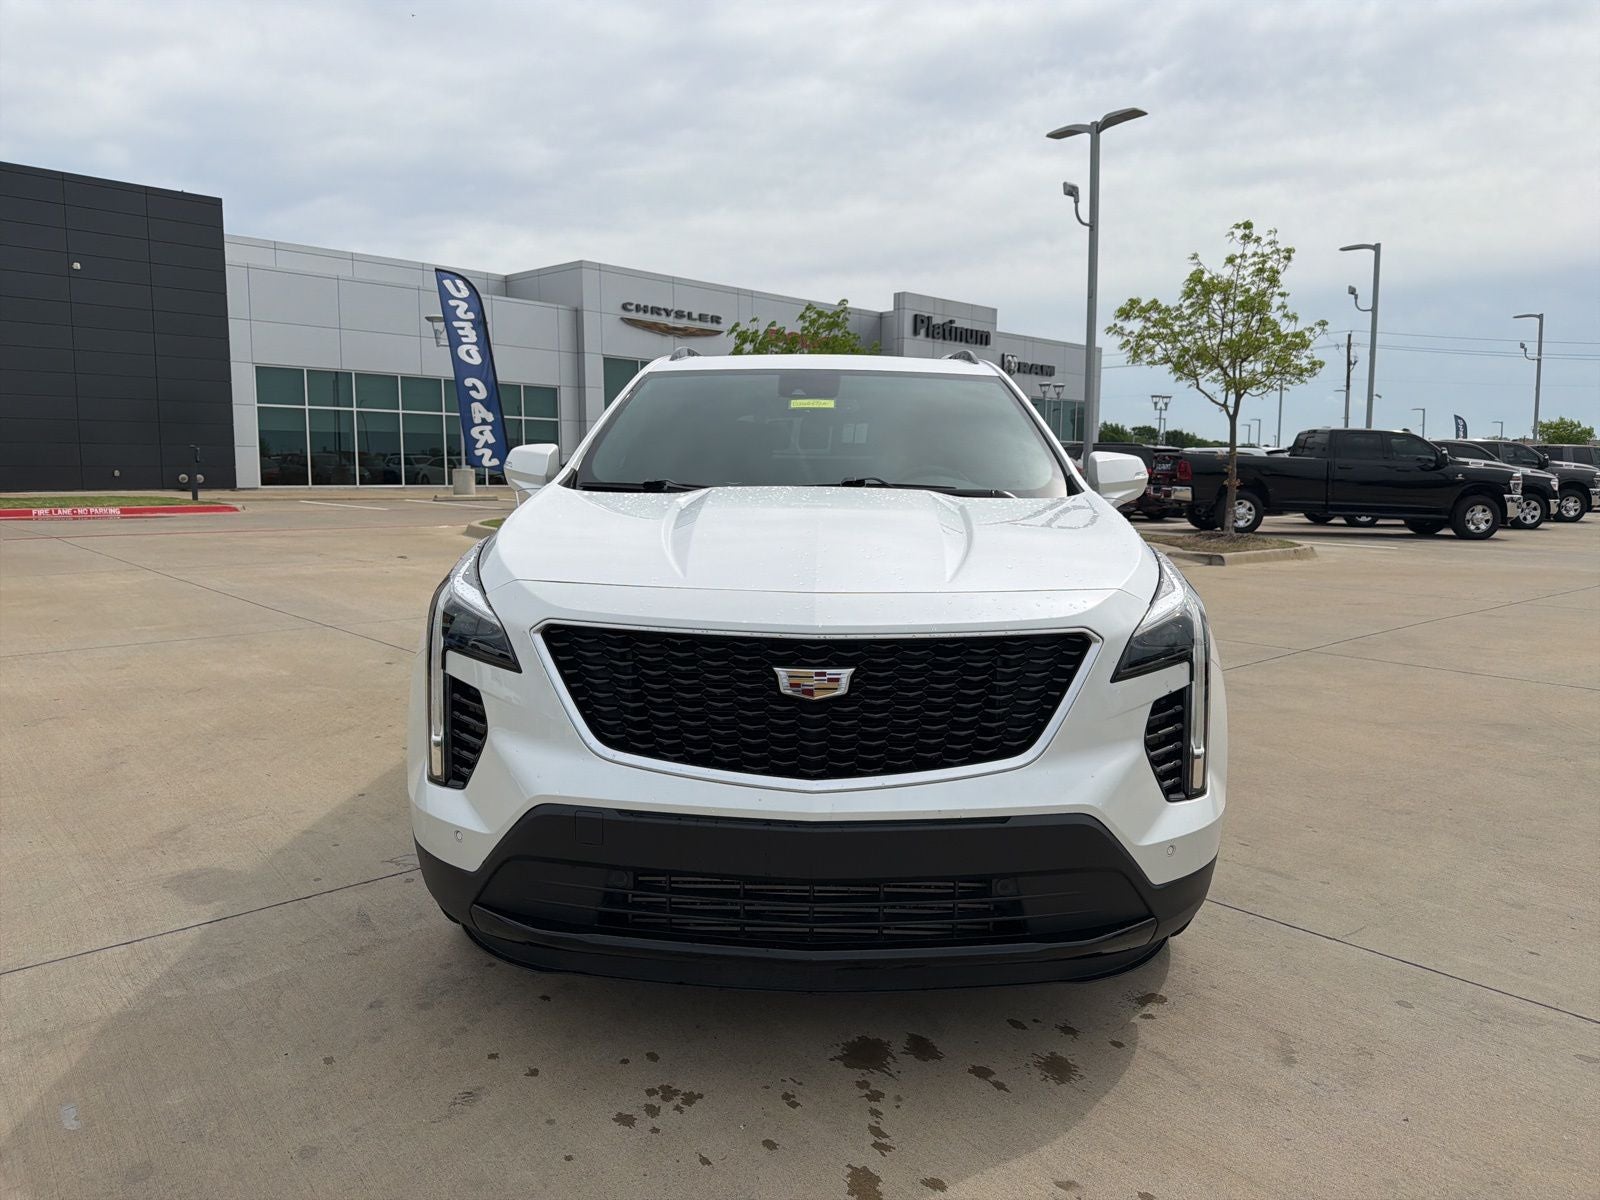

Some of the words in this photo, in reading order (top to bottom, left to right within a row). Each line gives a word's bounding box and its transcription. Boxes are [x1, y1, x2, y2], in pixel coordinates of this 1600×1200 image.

[621, 301, 722, 324] CHRYSLER
[913, 313, 991, 346] Platinum
[1018, 361, 1055, 377] RAM
[32, 509, 50, 517] FIRE
[52, 508, 72, 516] LANE
[90, 507, 120, 515] PARKING
